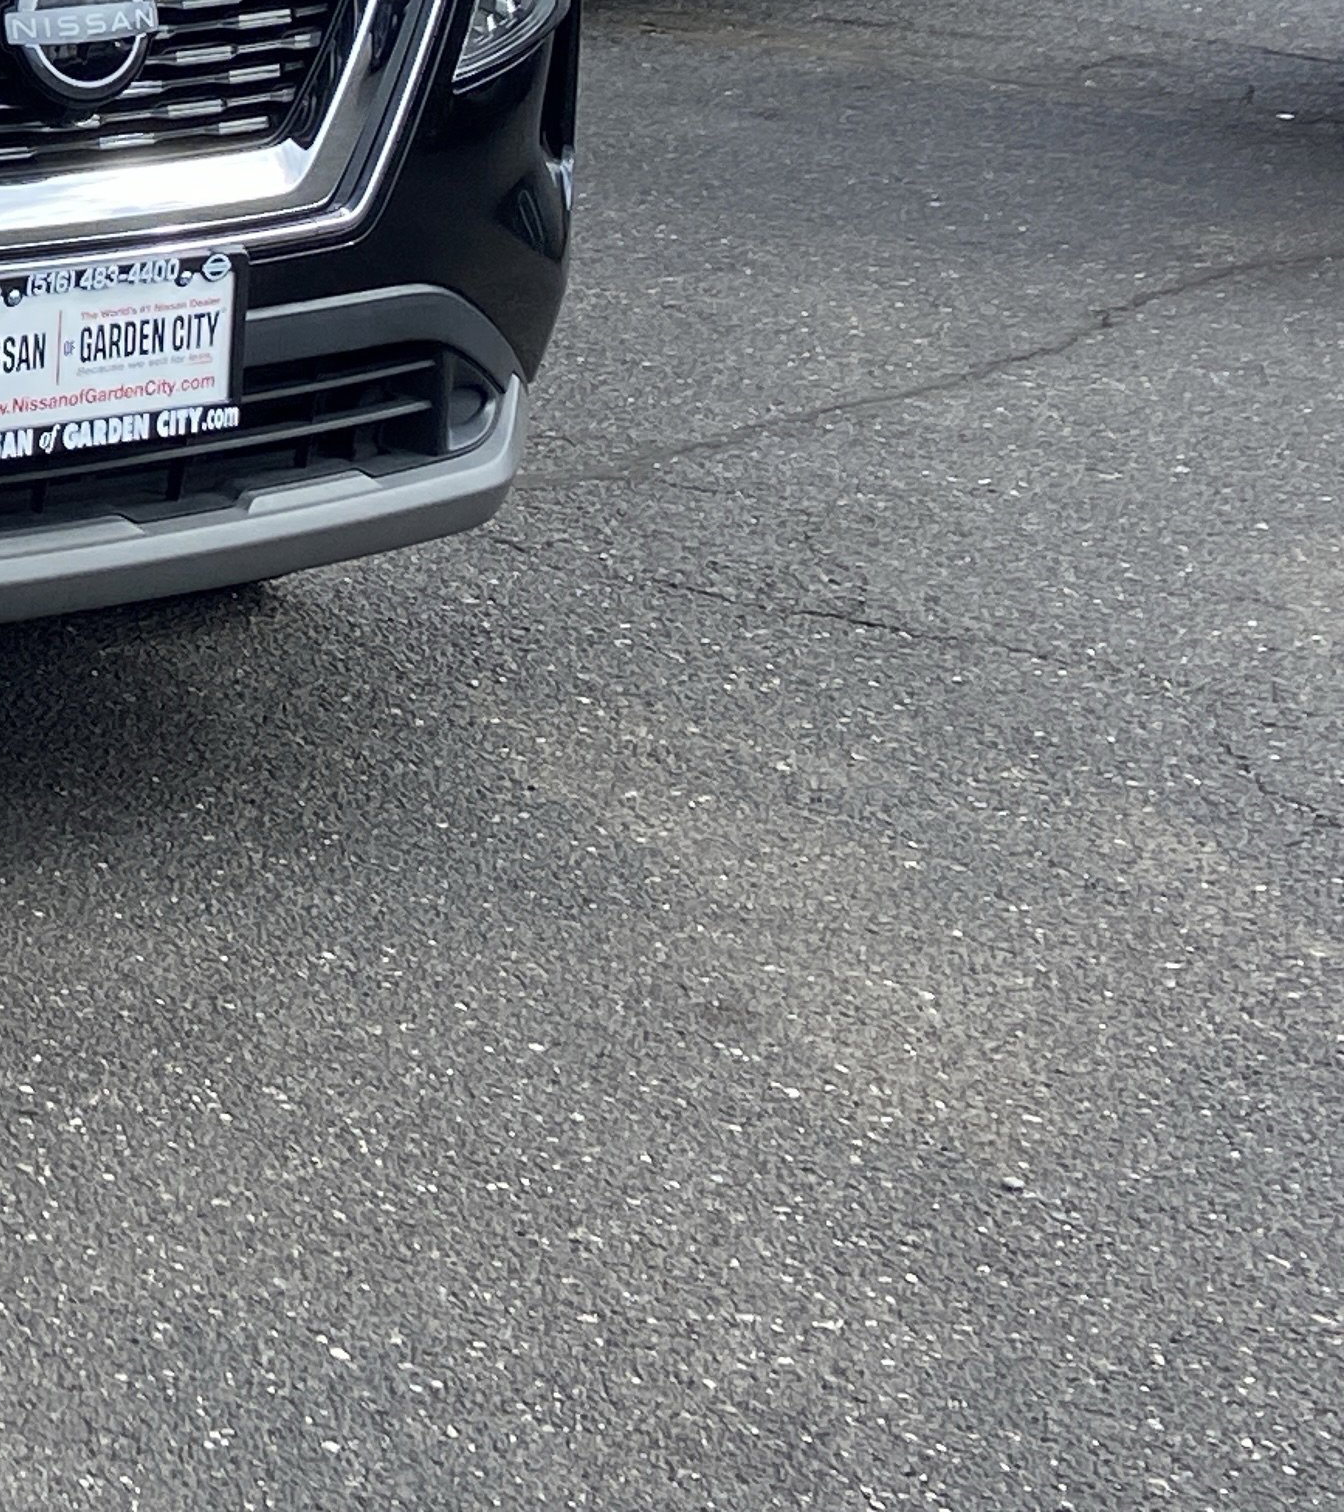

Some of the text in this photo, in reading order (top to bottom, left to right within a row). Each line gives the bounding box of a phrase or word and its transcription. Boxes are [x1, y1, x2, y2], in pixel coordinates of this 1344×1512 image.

[12, 6, 154, 40] NISSAN
[26, 257, 180, 297] (516) 483-4400
[79, 317, 166, 363] GARDEN
[171, 310, 220, 351] CITY
[39, 423, 61, 454] of
[62, 413, 150, 450] GARDEN
[156, 406, 241, 438] CITY.com
